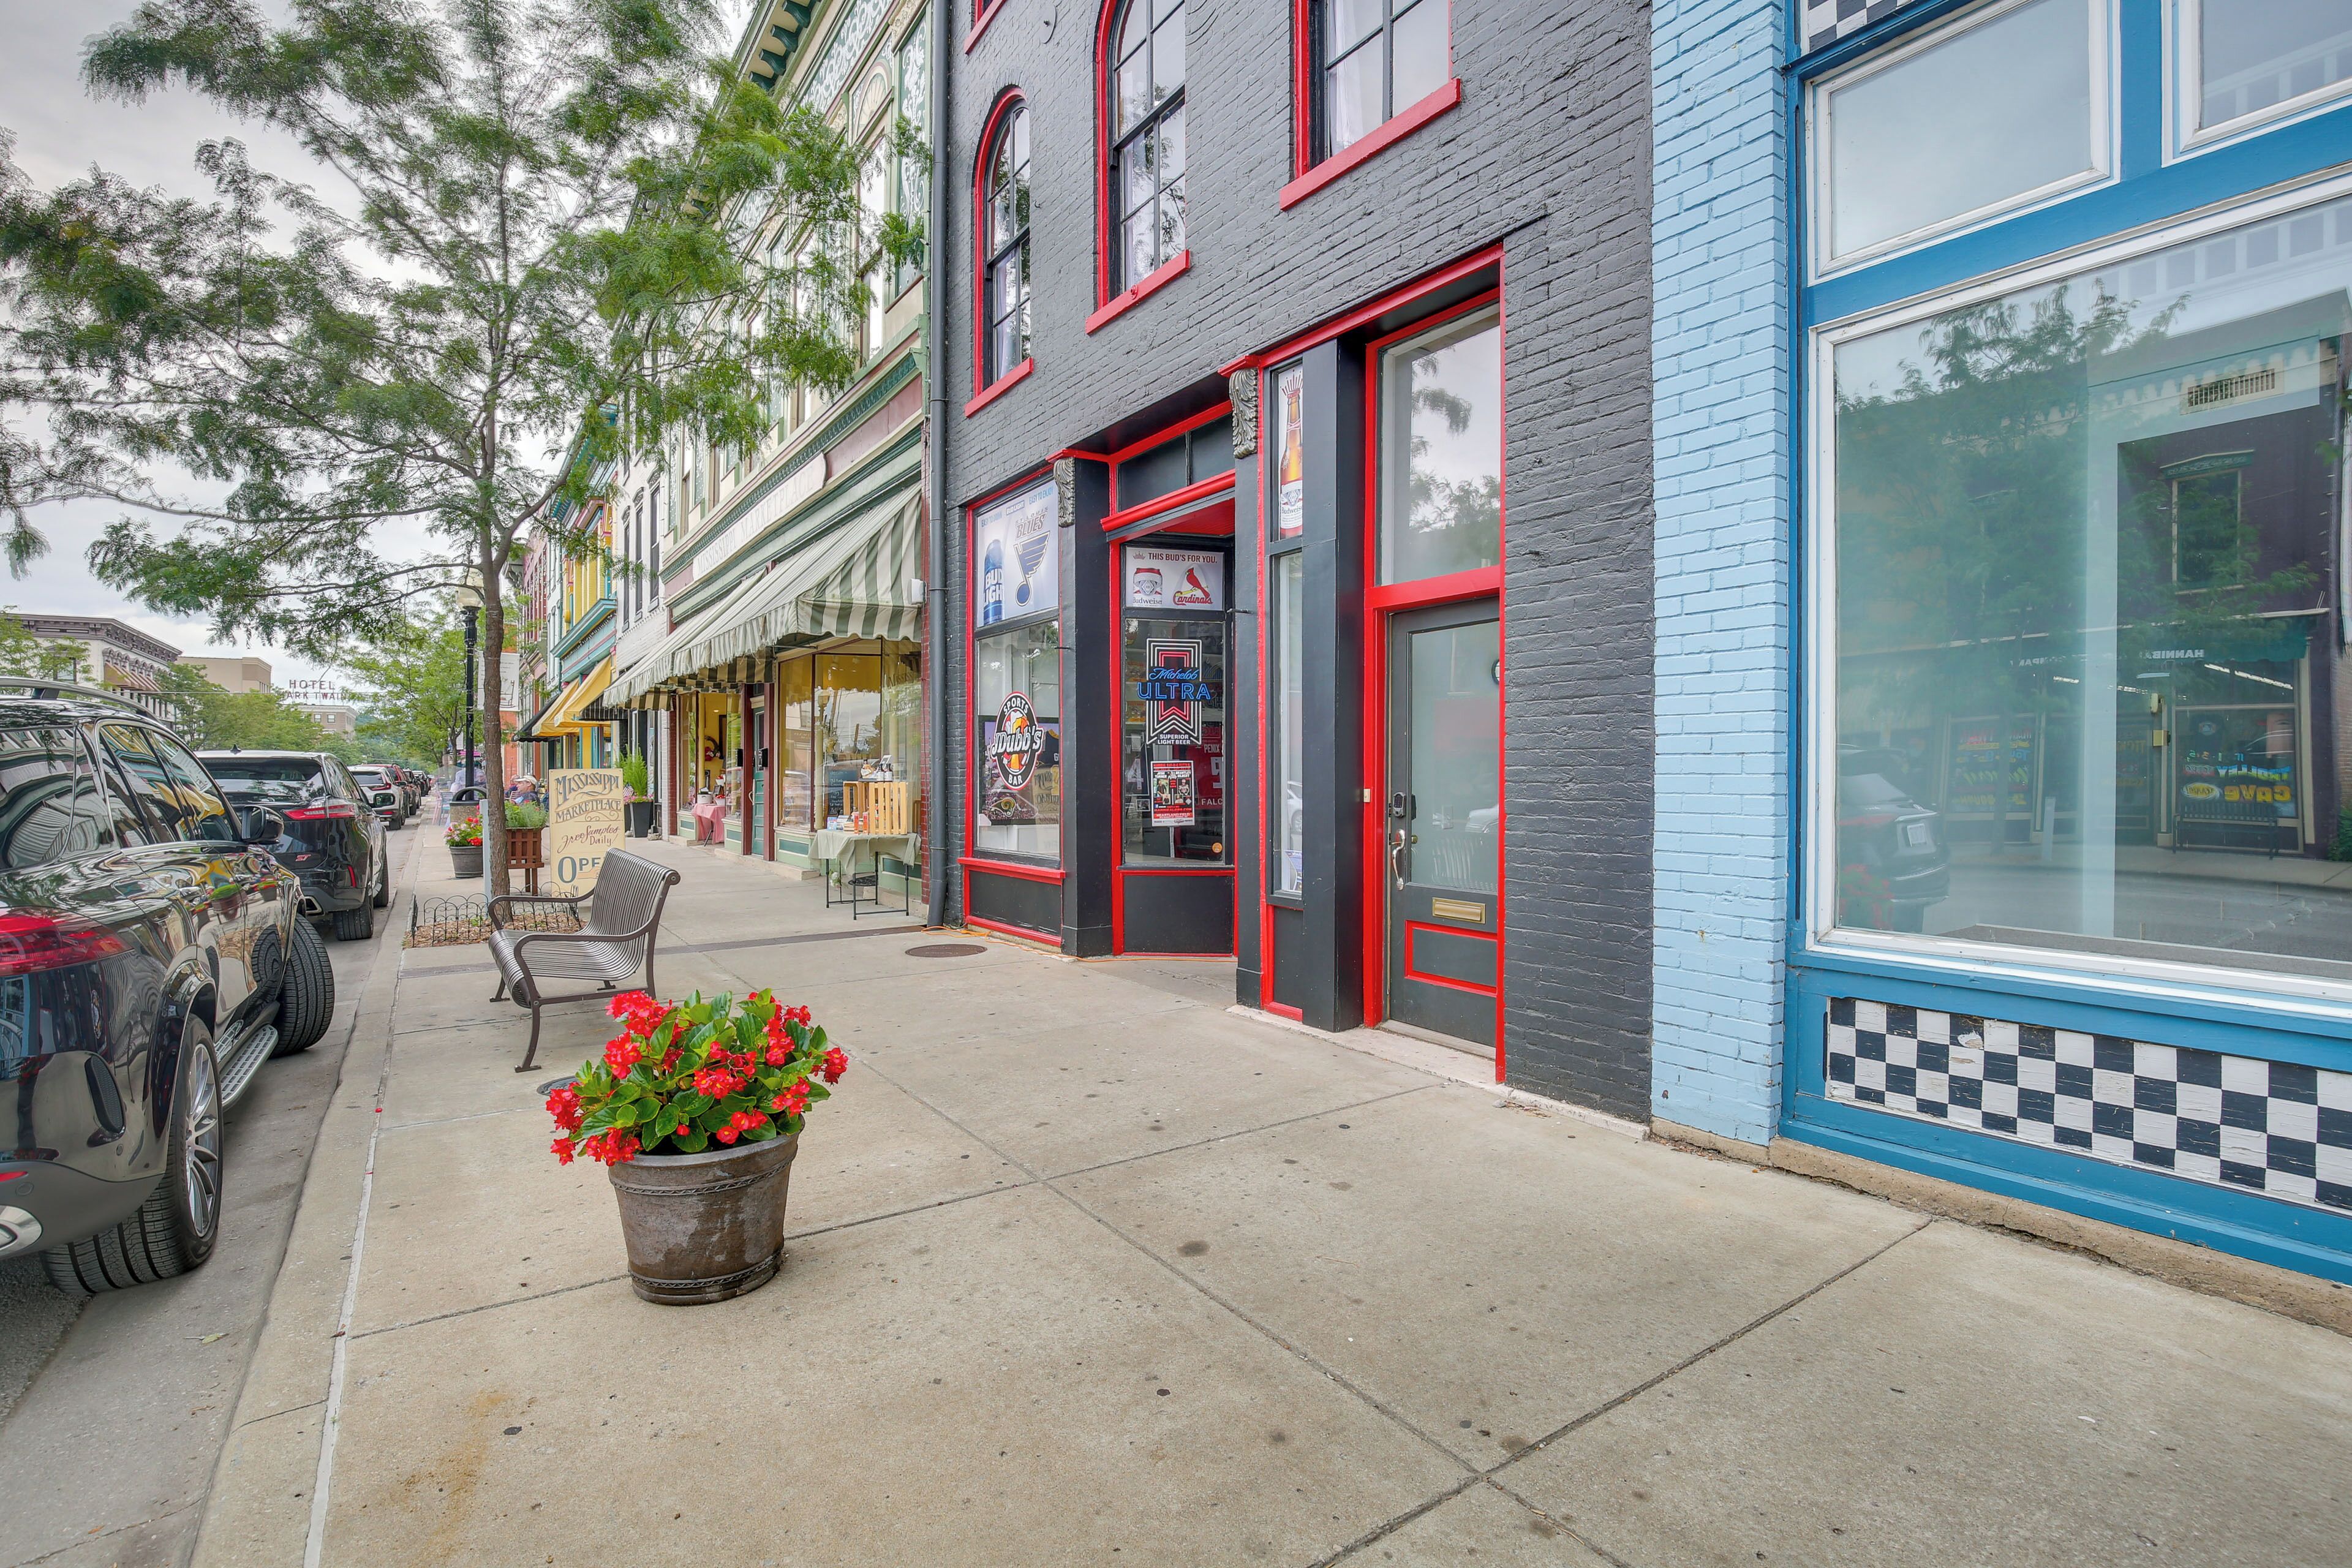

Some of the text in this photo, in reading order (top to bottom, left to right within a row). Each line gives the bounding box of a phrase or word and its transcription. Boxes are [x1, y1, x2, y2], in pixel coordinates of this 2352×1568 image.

[740, 467, 815, 541] MARKETPLACE
[1016, 514, 1046, 538] BLUES
[1173, 591, 1213, 606] Cardinals
[1149, 668, 1199, 680] Michelob
[289, 679, 336, 690] HOTEL
[1137, 682, 1211, 700] ULTRA
[281, 691, 347, 701] ARK TWAIN
[1003, 698, 1029, 715] SPORTS
[991, 725, 1042, 755] JDubb's
[1204, 744, 1220, 753] PENIX
[1008, 774, 1023, 785] BAR
[1128, 758, 1144, 790] 4
[554, 772, 619, 809] MISSISSIPPI
[556, 800, 622, 823] MARKETPLACE
[557, 824, 620, 854] Free Samples
[558, 856, 605, 883] OPE
